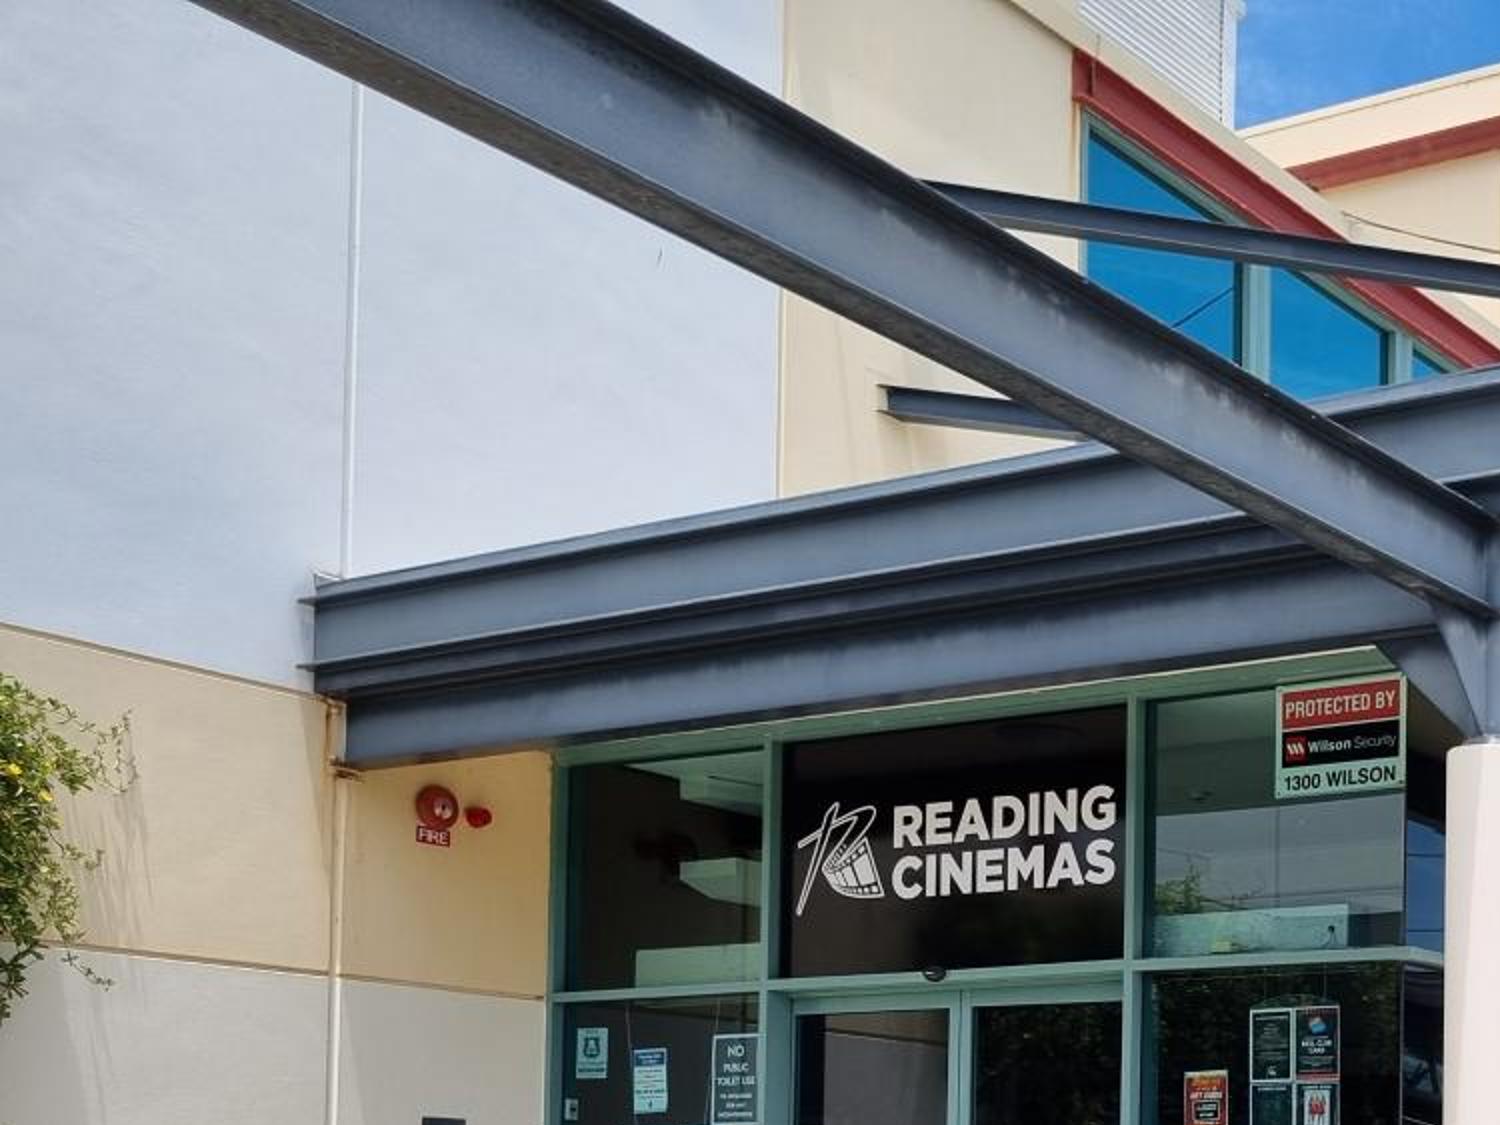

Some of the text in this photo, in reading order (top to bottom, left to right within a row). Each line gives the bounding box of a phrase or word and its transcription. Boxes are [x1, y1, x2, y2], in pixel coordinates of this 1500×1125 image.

[1285, 689, 1395, 719] PROTECTED BY
[1308, 735, 1396, 753] Wilson Security
[1284, 765, 1395, 791] 1300 WILSON
[892, 785, 1117, 849] READING
[418, 828, 449, 845] FIRE
[891, 839, 1116, 900] CINEMAS
[727, 1045, 745, 1057] NO
